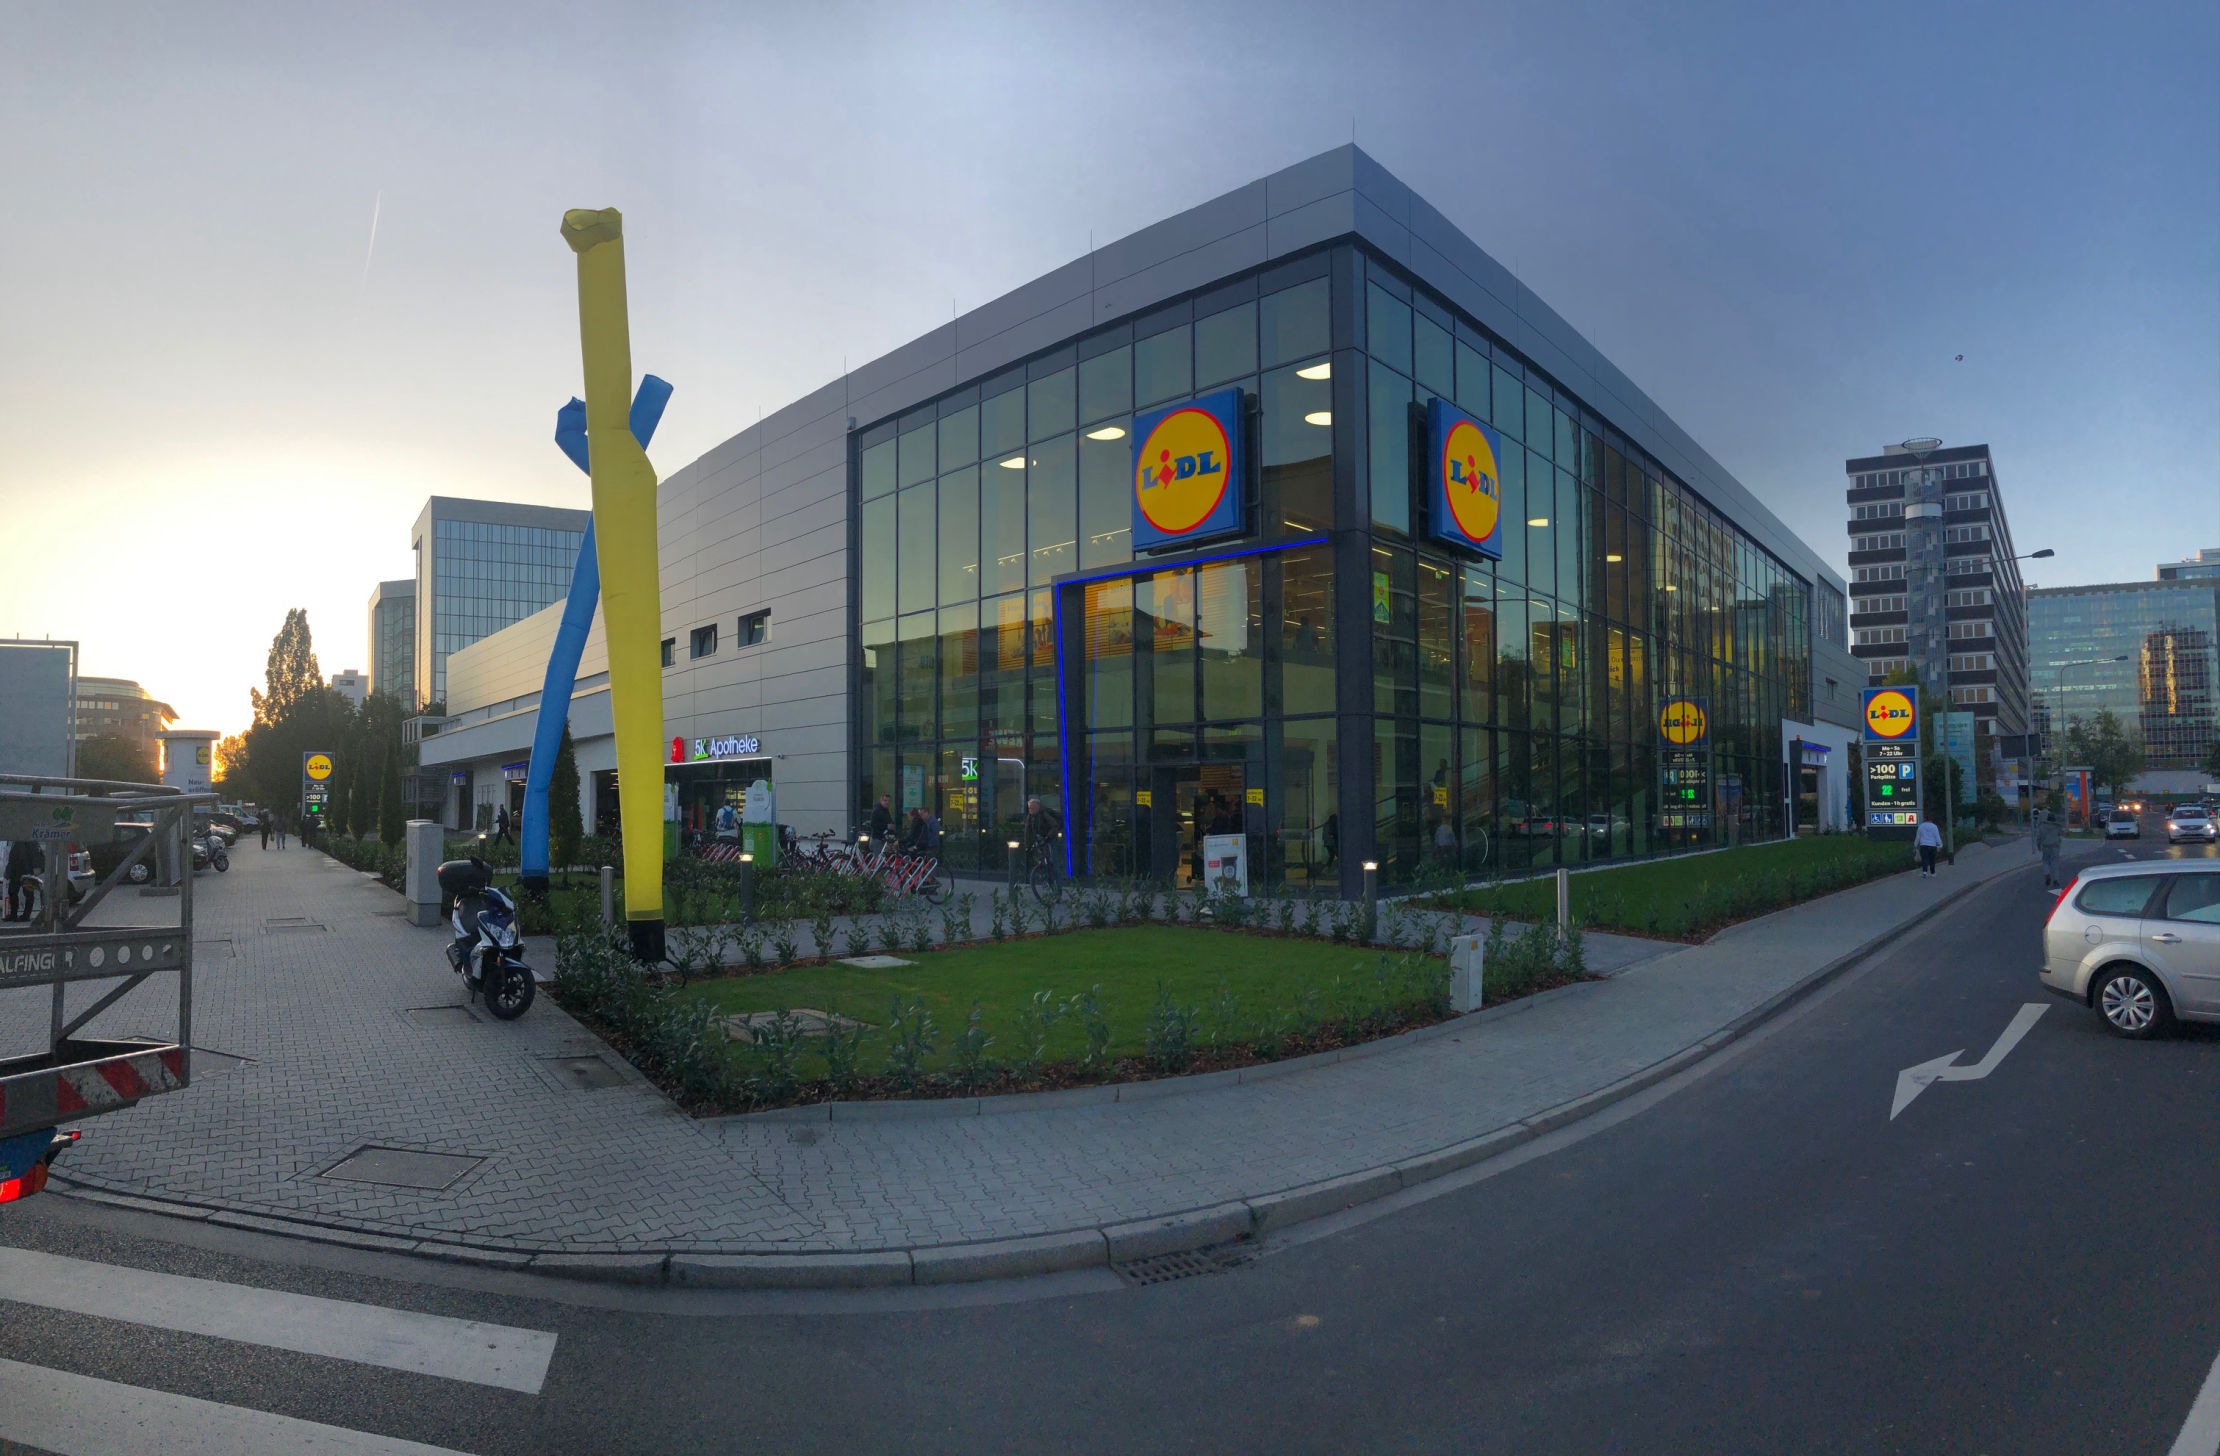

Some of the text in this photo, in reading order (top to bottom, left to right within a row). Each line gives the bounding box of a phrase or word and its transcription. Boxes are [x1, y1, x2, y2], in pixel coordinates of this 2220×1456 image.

[710, 734, 758, 759] Apotheke
[1902, 765, 1911, 777] P
[1881, 784, 1893, 796] 22
